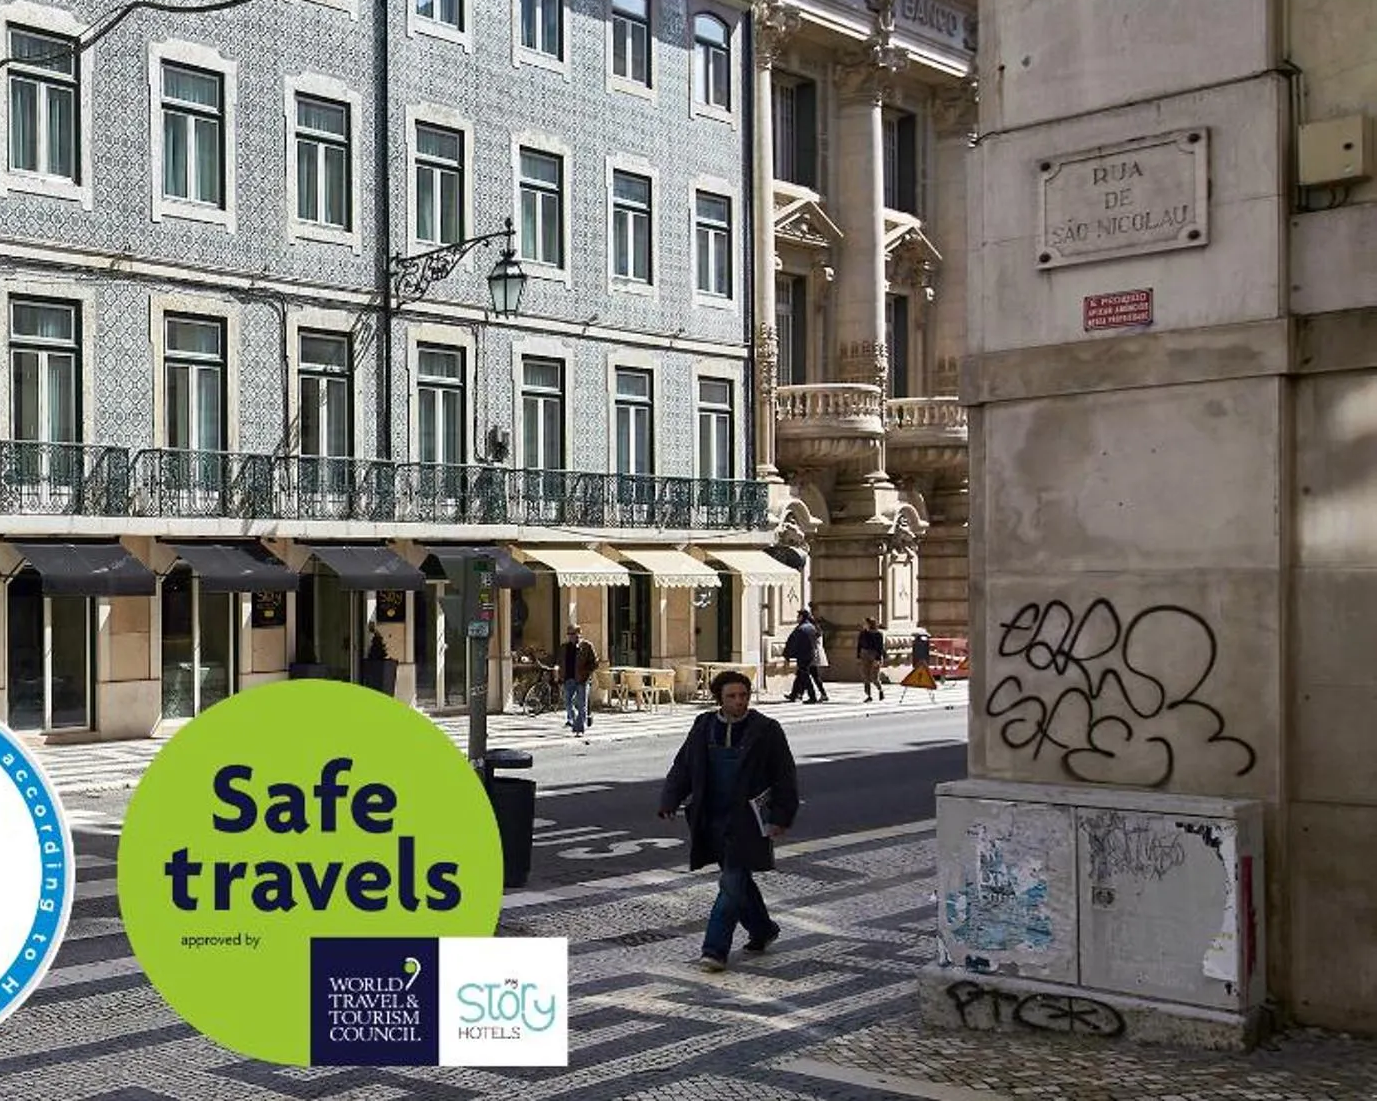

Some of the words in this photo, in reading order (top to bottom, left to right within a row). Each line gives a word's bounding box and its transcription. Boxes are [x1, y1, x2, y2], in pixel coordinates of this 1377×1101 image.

[1092, 161, 1144, 186] RUA
[1103, 188, 1133, 210] DE
[1096, 204, 1189, 239] NICOLAU
